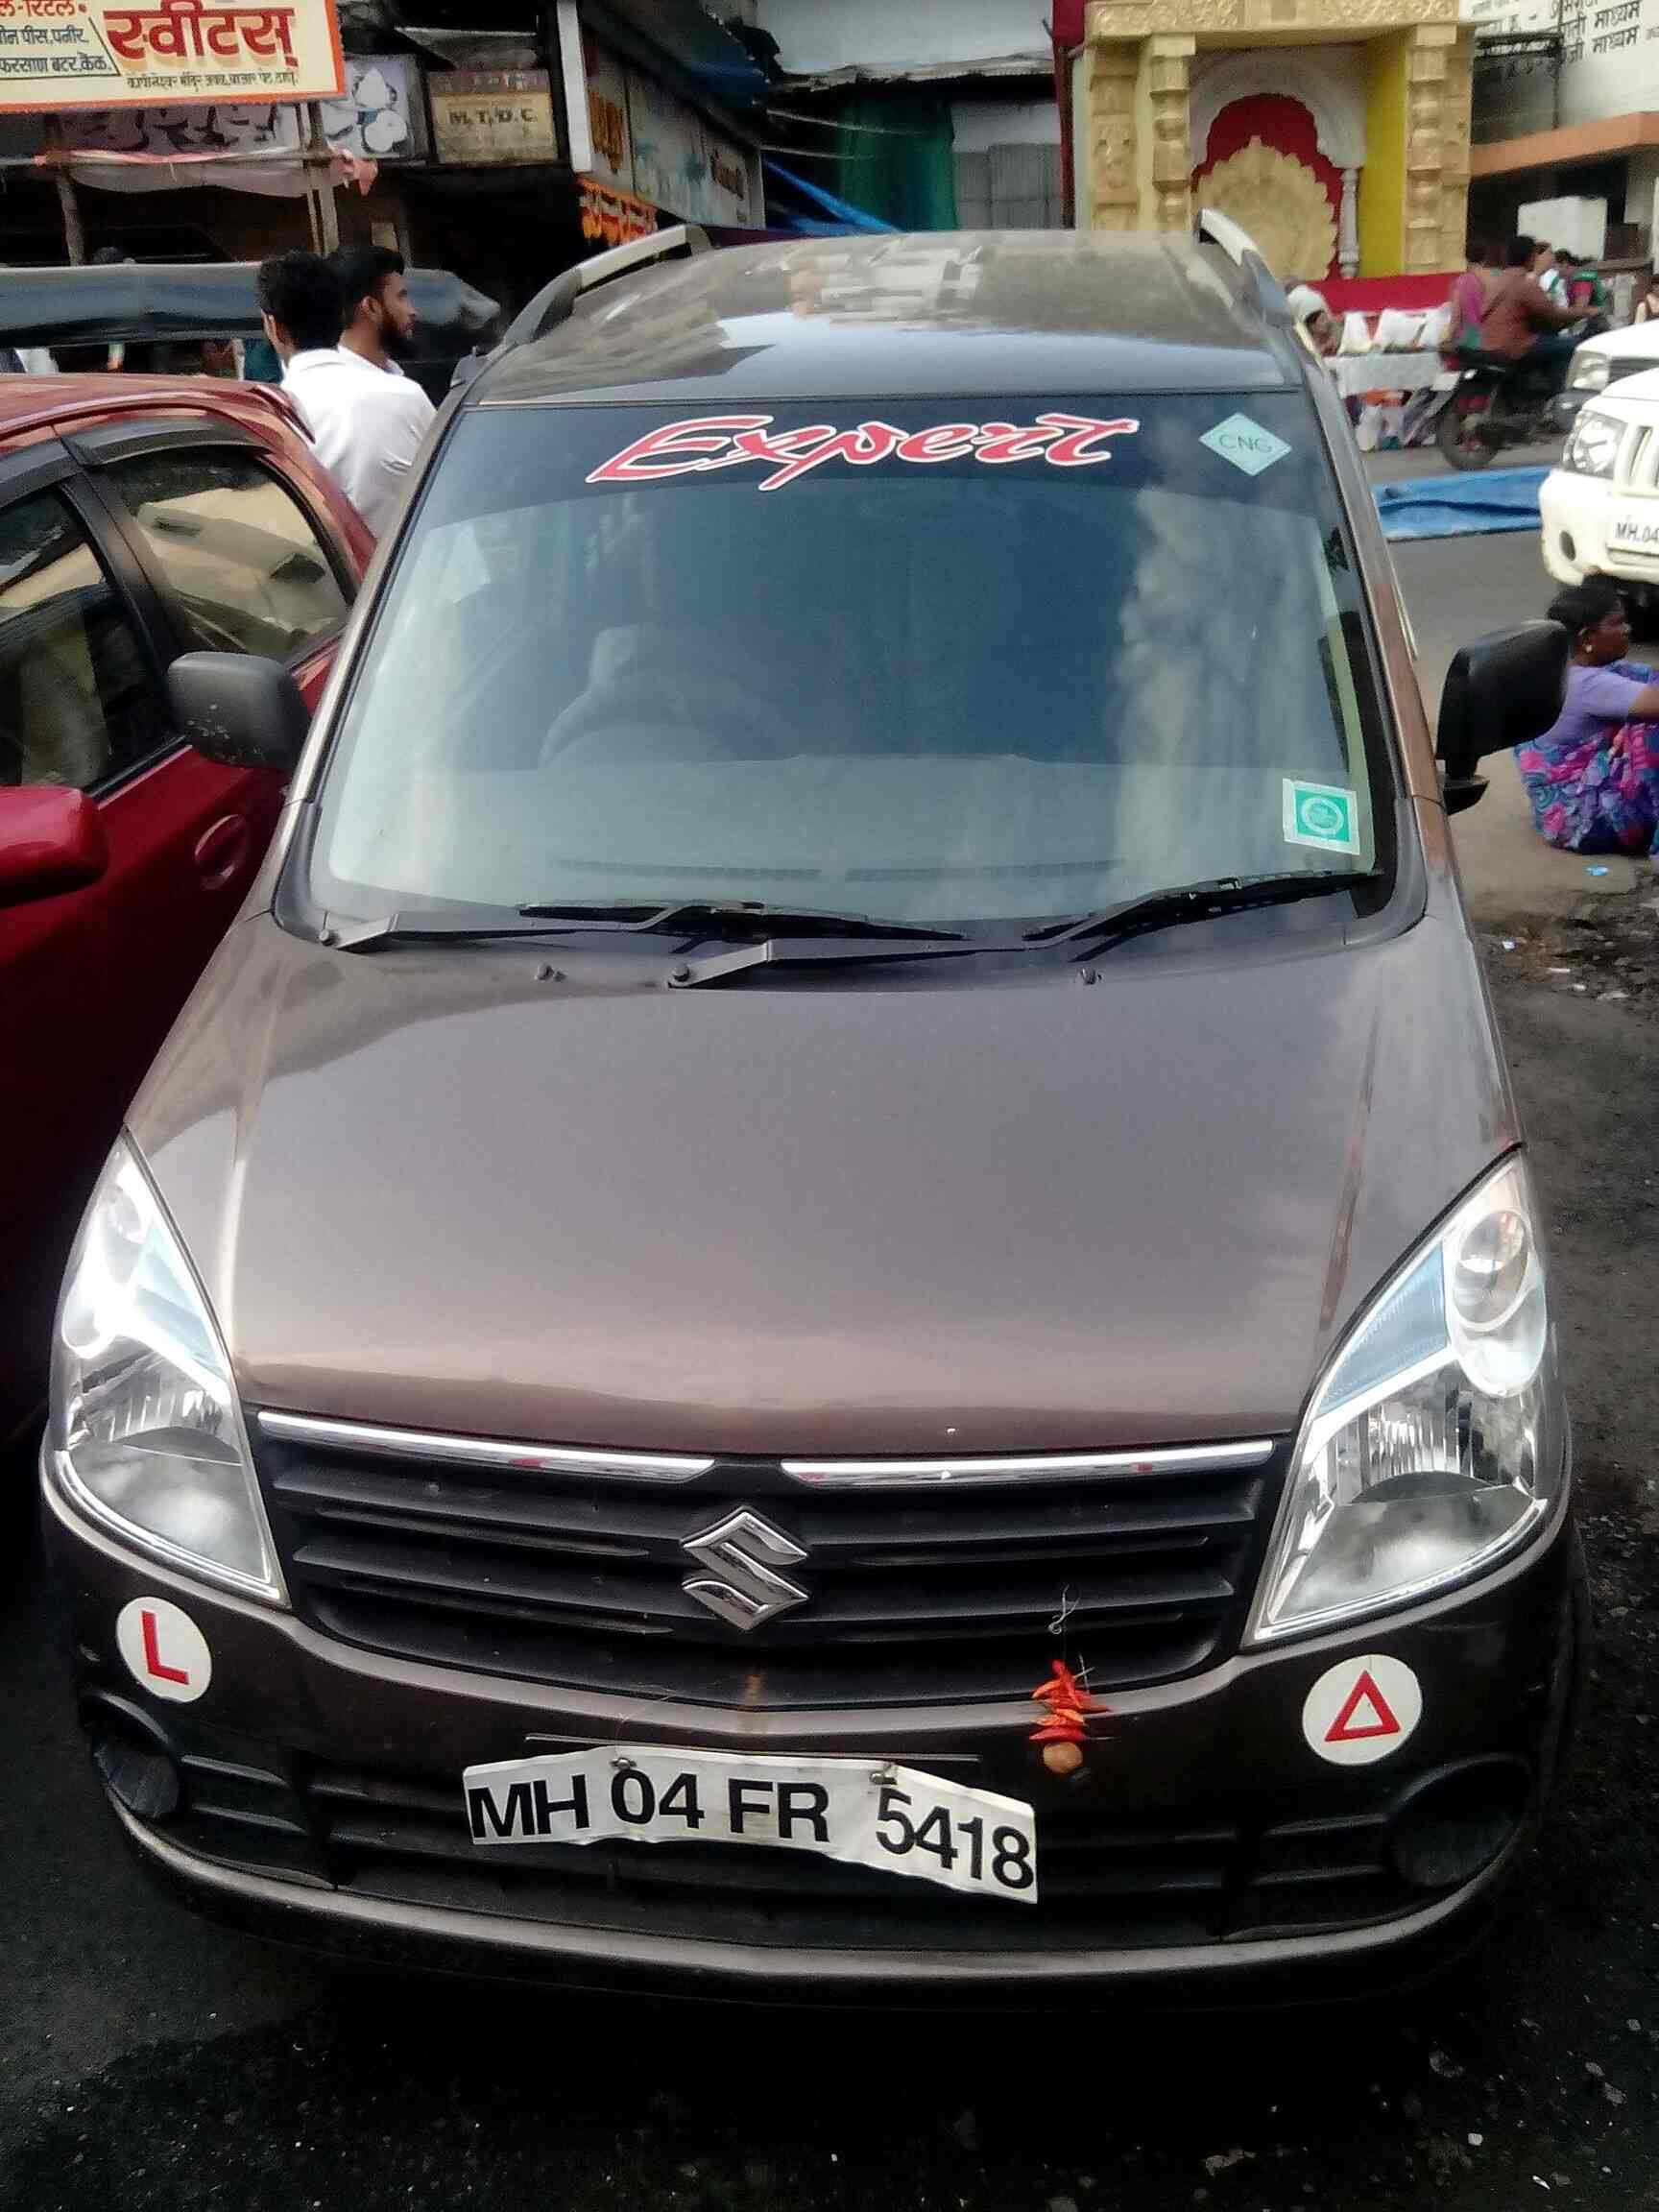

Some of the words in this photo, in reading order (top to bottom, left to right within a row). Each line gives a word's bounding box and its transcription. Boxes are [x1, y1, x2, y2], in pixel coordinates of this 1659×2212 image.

[585, 413, 1140, 491] Expert
[1218, 434, 1274, 454] CNG
[141, 1609, 190, 1686] L
[468, 1773, 590, 1839] MH
[611, 1768, 706, 1830] 04
[729, 1778, 830, 1843] FR
[875, 1787, 1035, 1891] 5418
